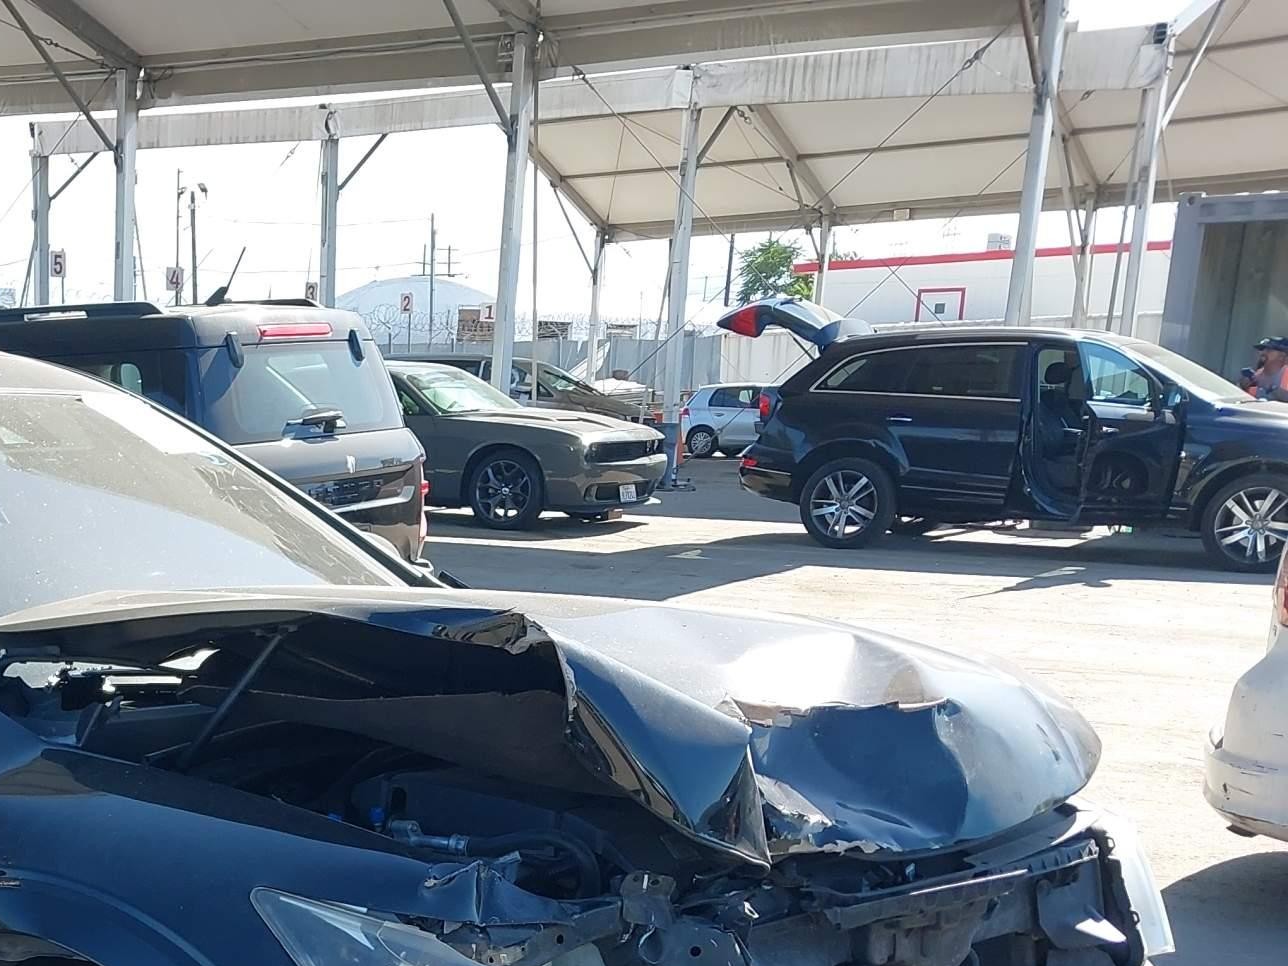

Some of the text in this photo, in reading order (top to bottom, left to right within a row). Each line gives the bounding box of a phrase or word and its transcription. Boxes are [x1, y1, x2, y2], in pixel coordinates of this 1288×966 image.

[53, 254, 63, 274] 5
[168, 269, 180, 286] 4
[402, 295, 411, 312] 2
[483, 304, 495, 320] 1
